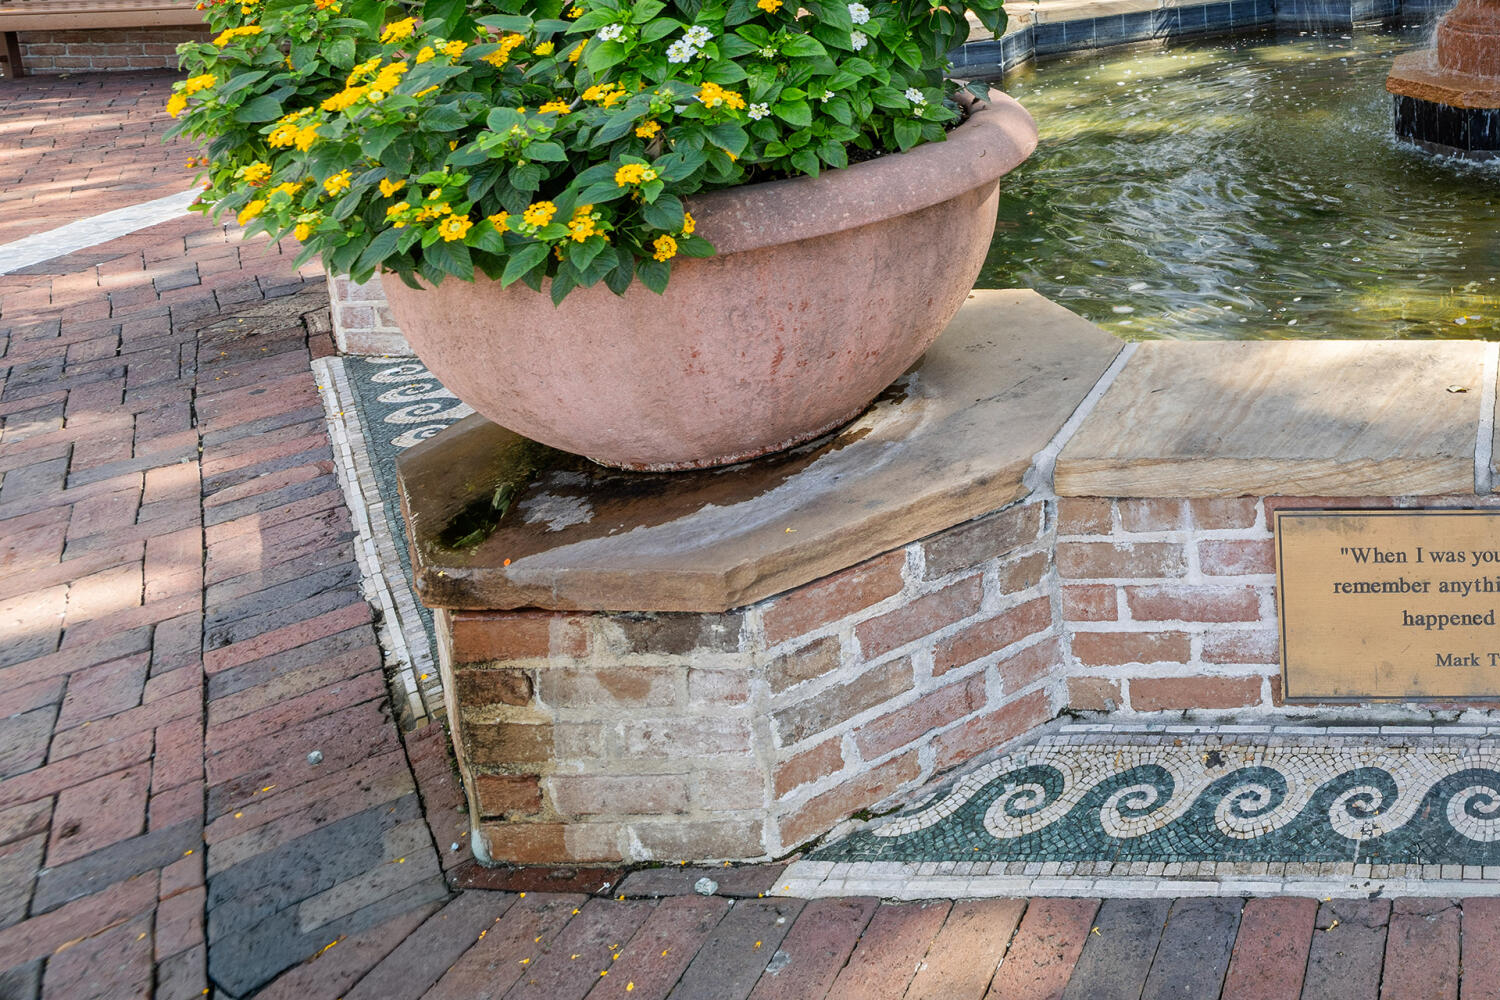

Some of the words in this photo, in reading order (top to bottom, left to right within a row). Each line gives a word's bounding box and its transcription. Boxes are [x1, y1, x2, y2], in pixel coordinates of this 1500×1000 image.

[1340, 547, 1407, 564] "When
[1416, 547, 1423, 563] I
[1428, 551, 1466, 563] was
[1333, 577, 1431, 594] remember
[1402, 609, 1496, 631] happened
[1435, 652, 1480, 667] Mark
